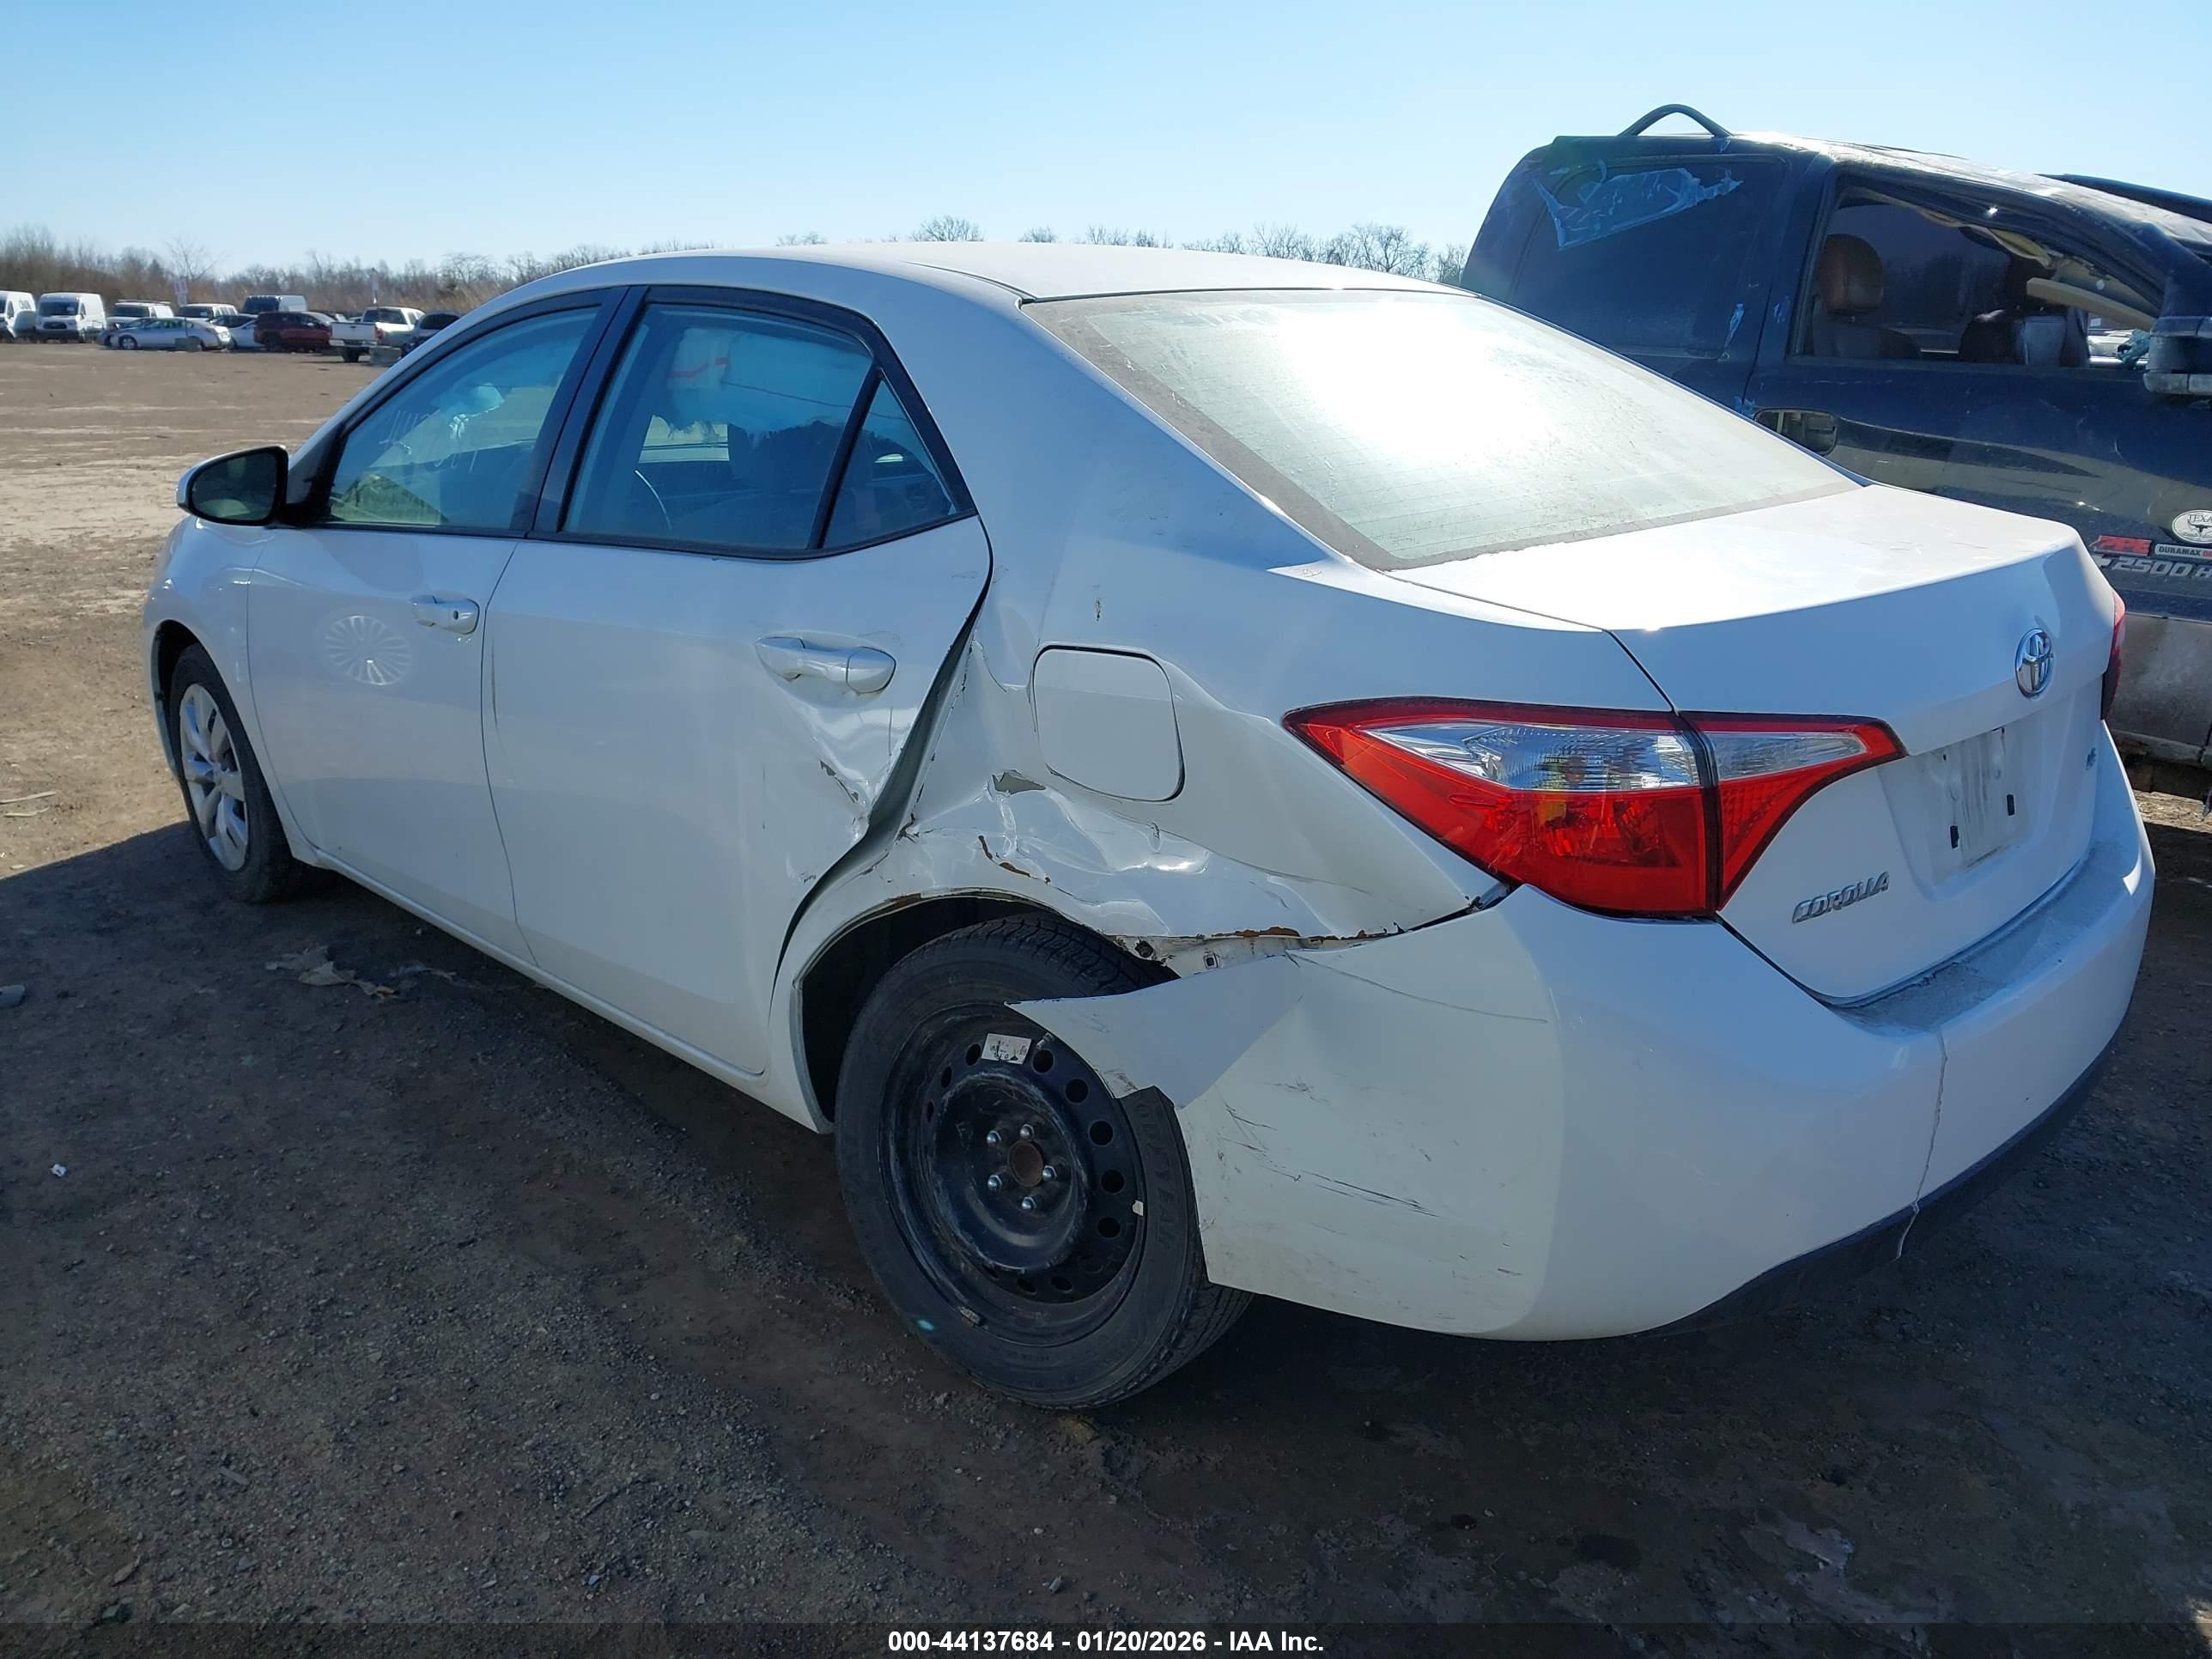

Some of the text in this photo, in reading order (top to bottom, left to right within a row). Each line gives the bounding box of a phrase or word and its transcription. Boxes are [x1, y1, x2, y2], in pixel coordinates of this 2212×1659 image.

[2159, 545, 2200, 556] DURAMAX
[2112, 556, 2193, 577] 2500
[1791, 871, 1890, 924] COROLLA
